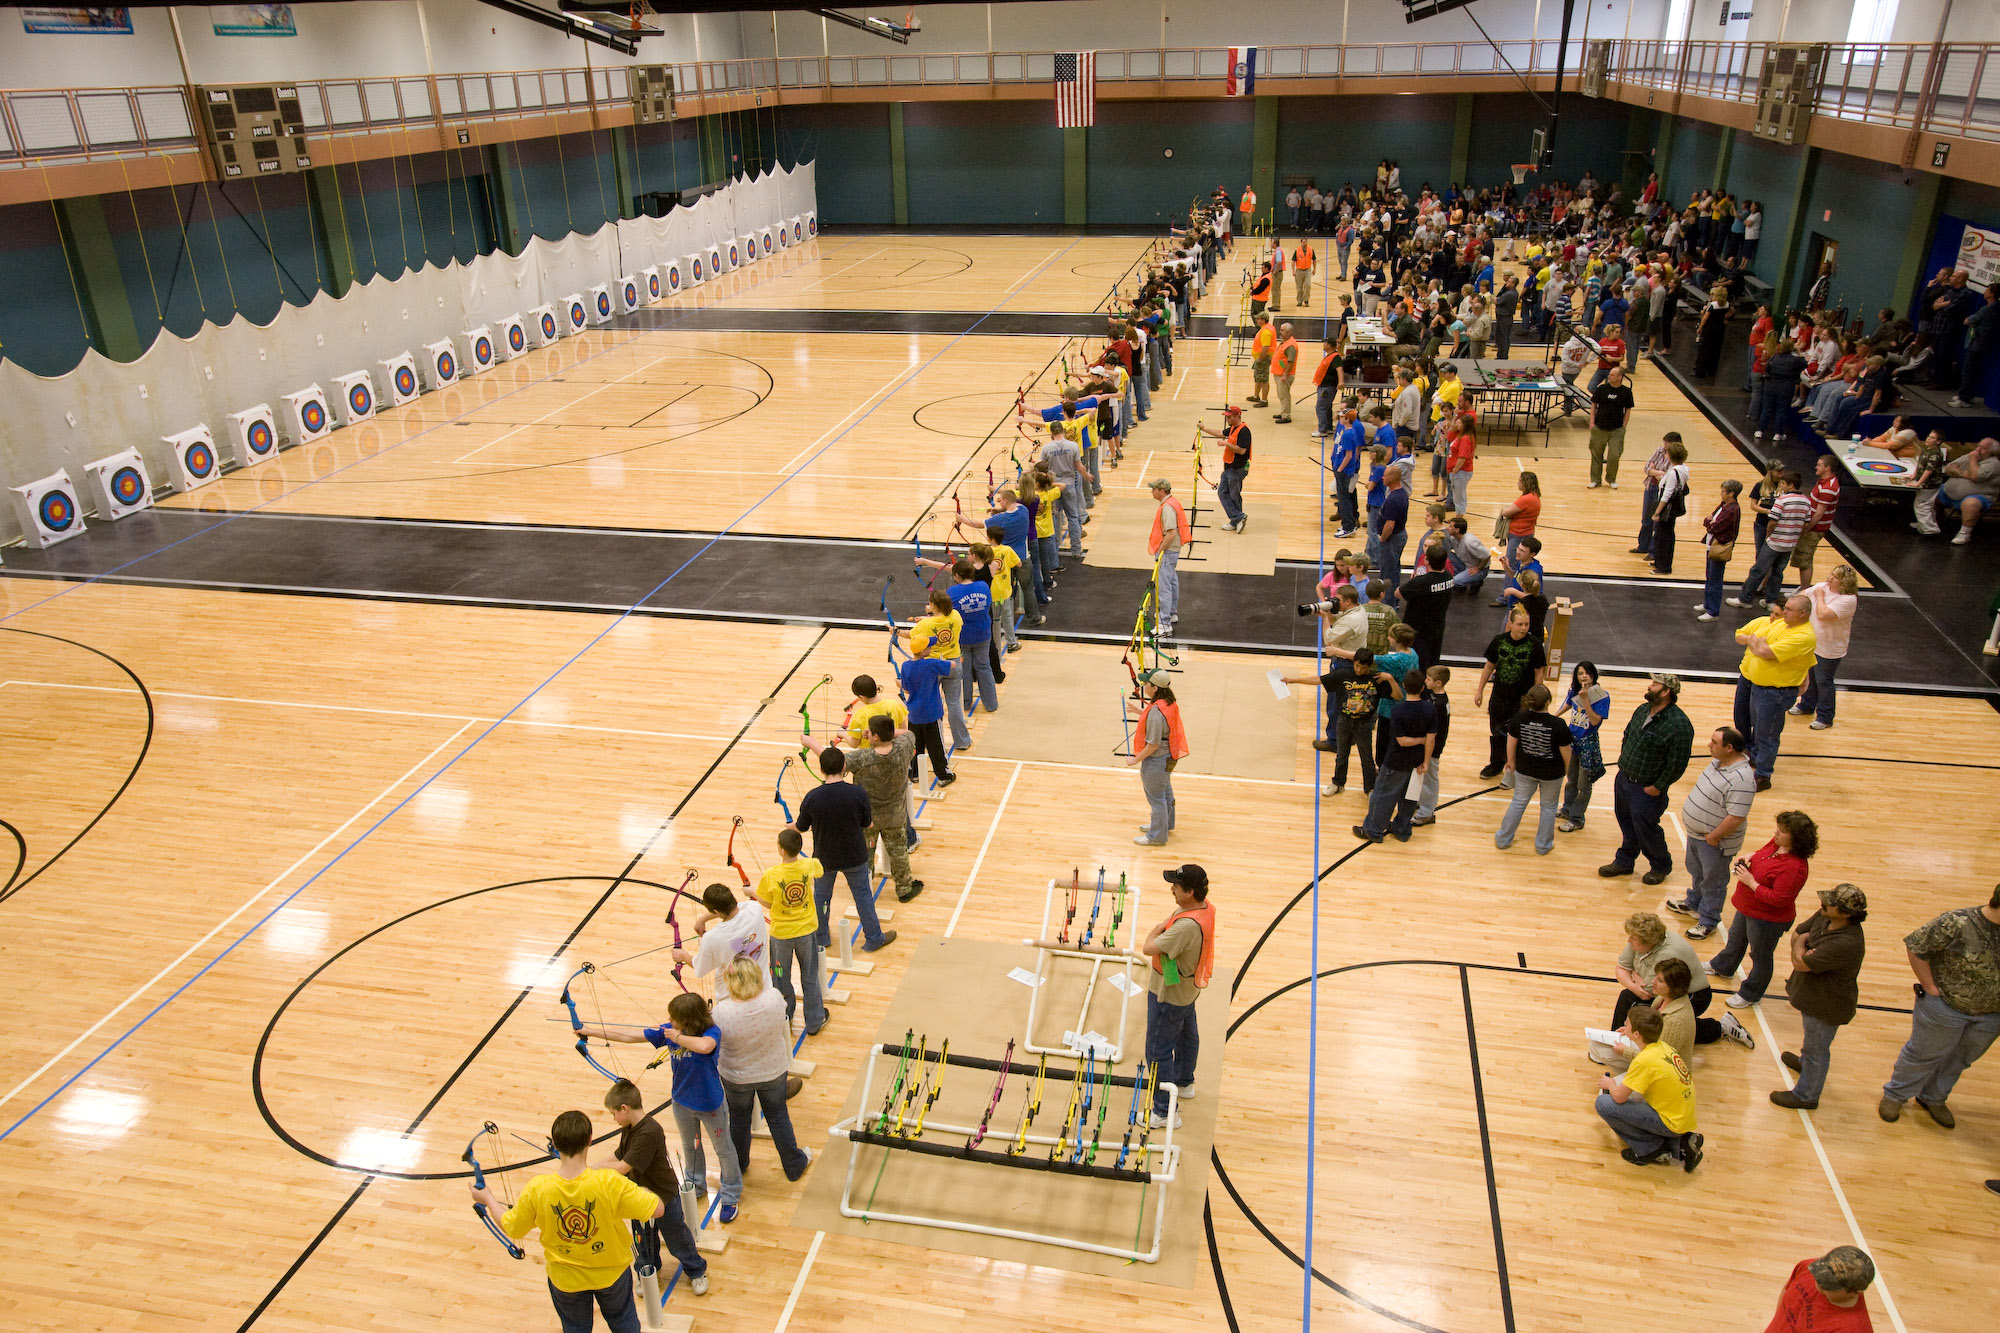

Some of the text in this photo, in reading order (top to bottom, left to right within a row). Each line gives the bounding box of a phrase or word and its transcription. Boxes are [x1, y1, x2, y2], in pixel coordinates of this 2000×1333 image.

[209, 91, 229, 102] Home
[277, 87, 297, 98] Guests
[253, 125, 271, 138] period
[260, 160, 279, 172] player
[297, 157, 311, 166] fouls
[226, 166, 241, 174] fouls
[1431, 582, 1446, 592] COACH
